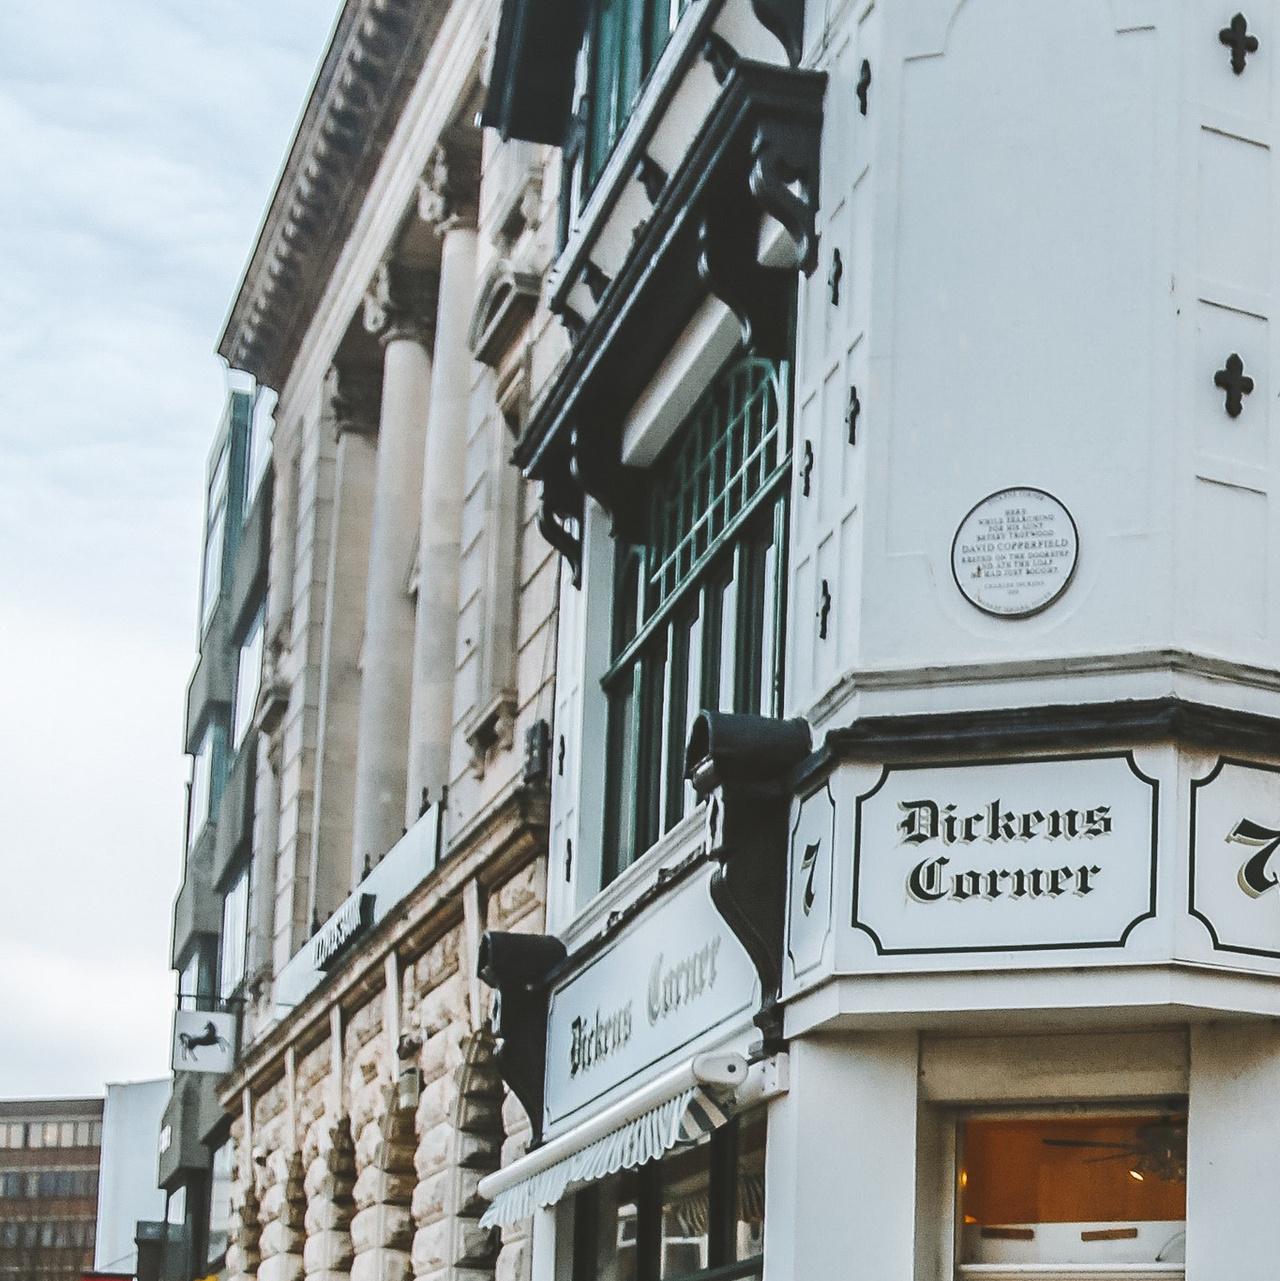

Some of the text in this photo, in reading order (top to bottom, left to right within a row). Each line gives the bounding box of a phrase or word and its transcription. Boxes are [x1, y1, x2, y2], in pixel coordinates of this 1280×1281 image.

[961, 539, 1069, 554] DAVID COPPERFIELD
[897, 797, 1114, 847] Dickens
[904, 856, 1103, 905] Corner
